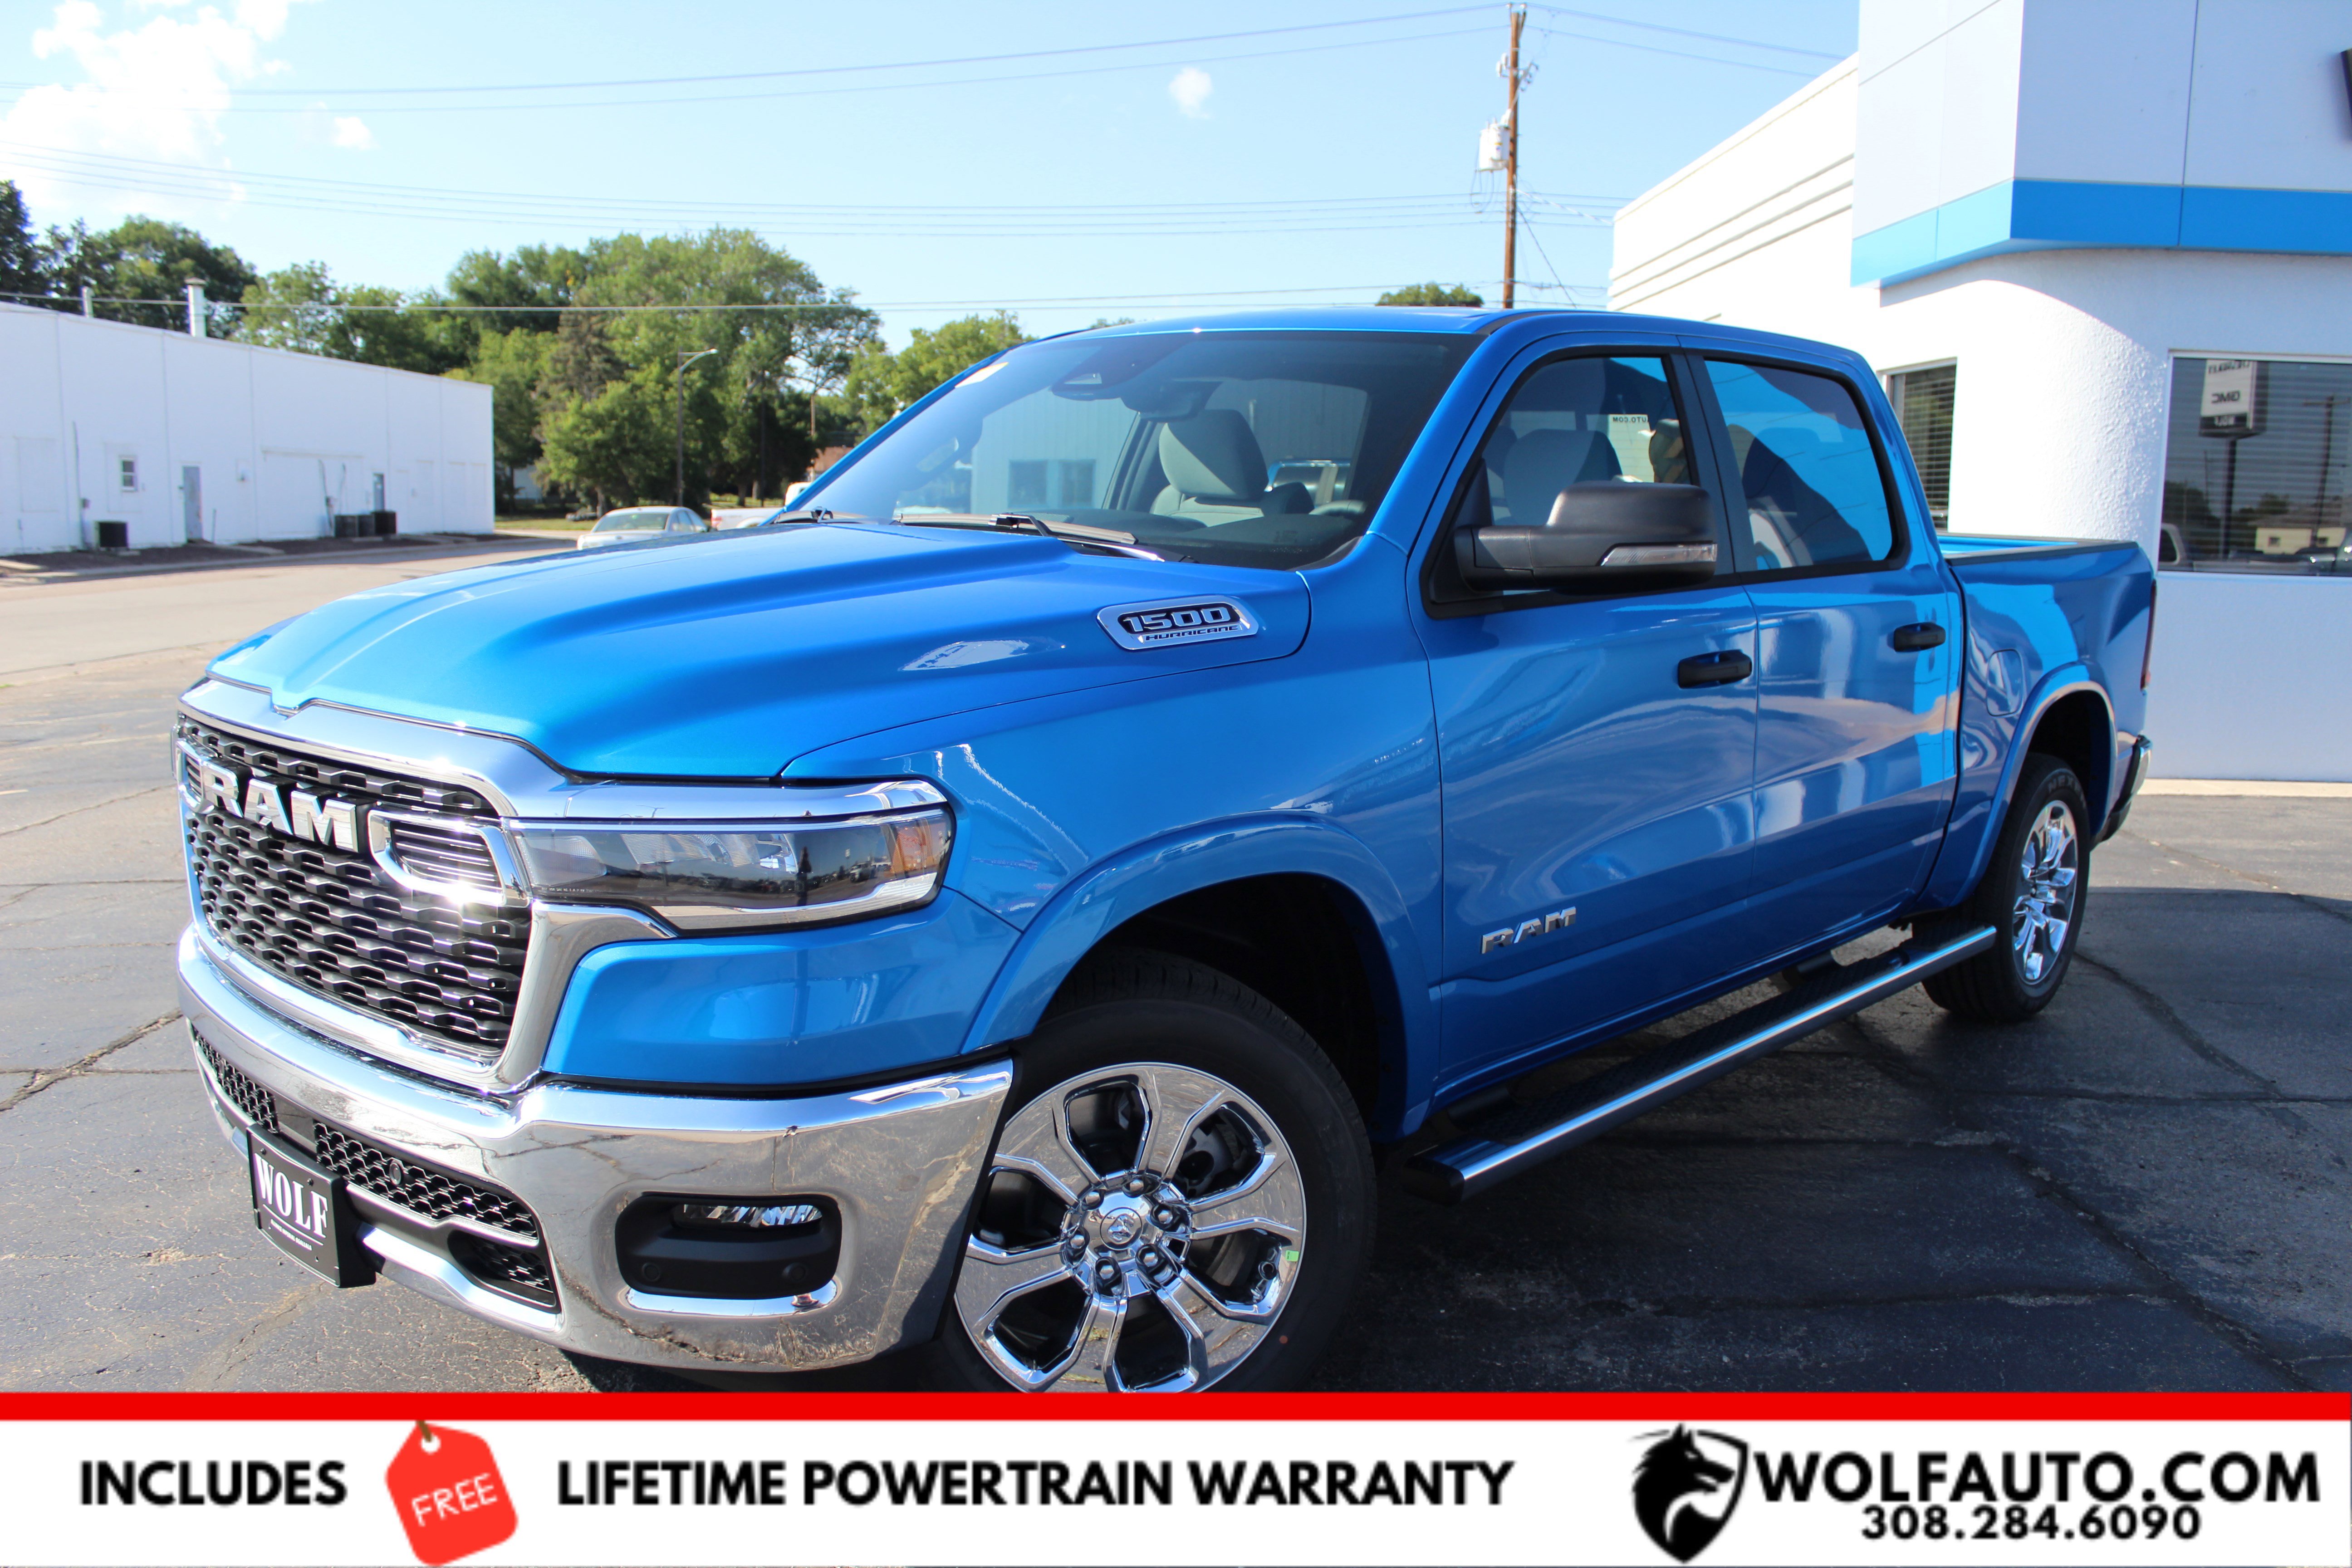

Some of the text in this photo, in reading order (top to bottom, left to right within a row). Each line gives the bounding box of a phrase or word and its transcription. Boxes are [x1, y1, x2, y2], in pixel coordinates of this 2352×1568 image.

[1124, 606, 1231, 632] 1500
[1145, 625, 1238, 641] HURRICANE
[201, 759, 359, 853] RAM
[1481, 906, 1577, 954] RAM
[255, 1152, 328, 1238] WOLF
